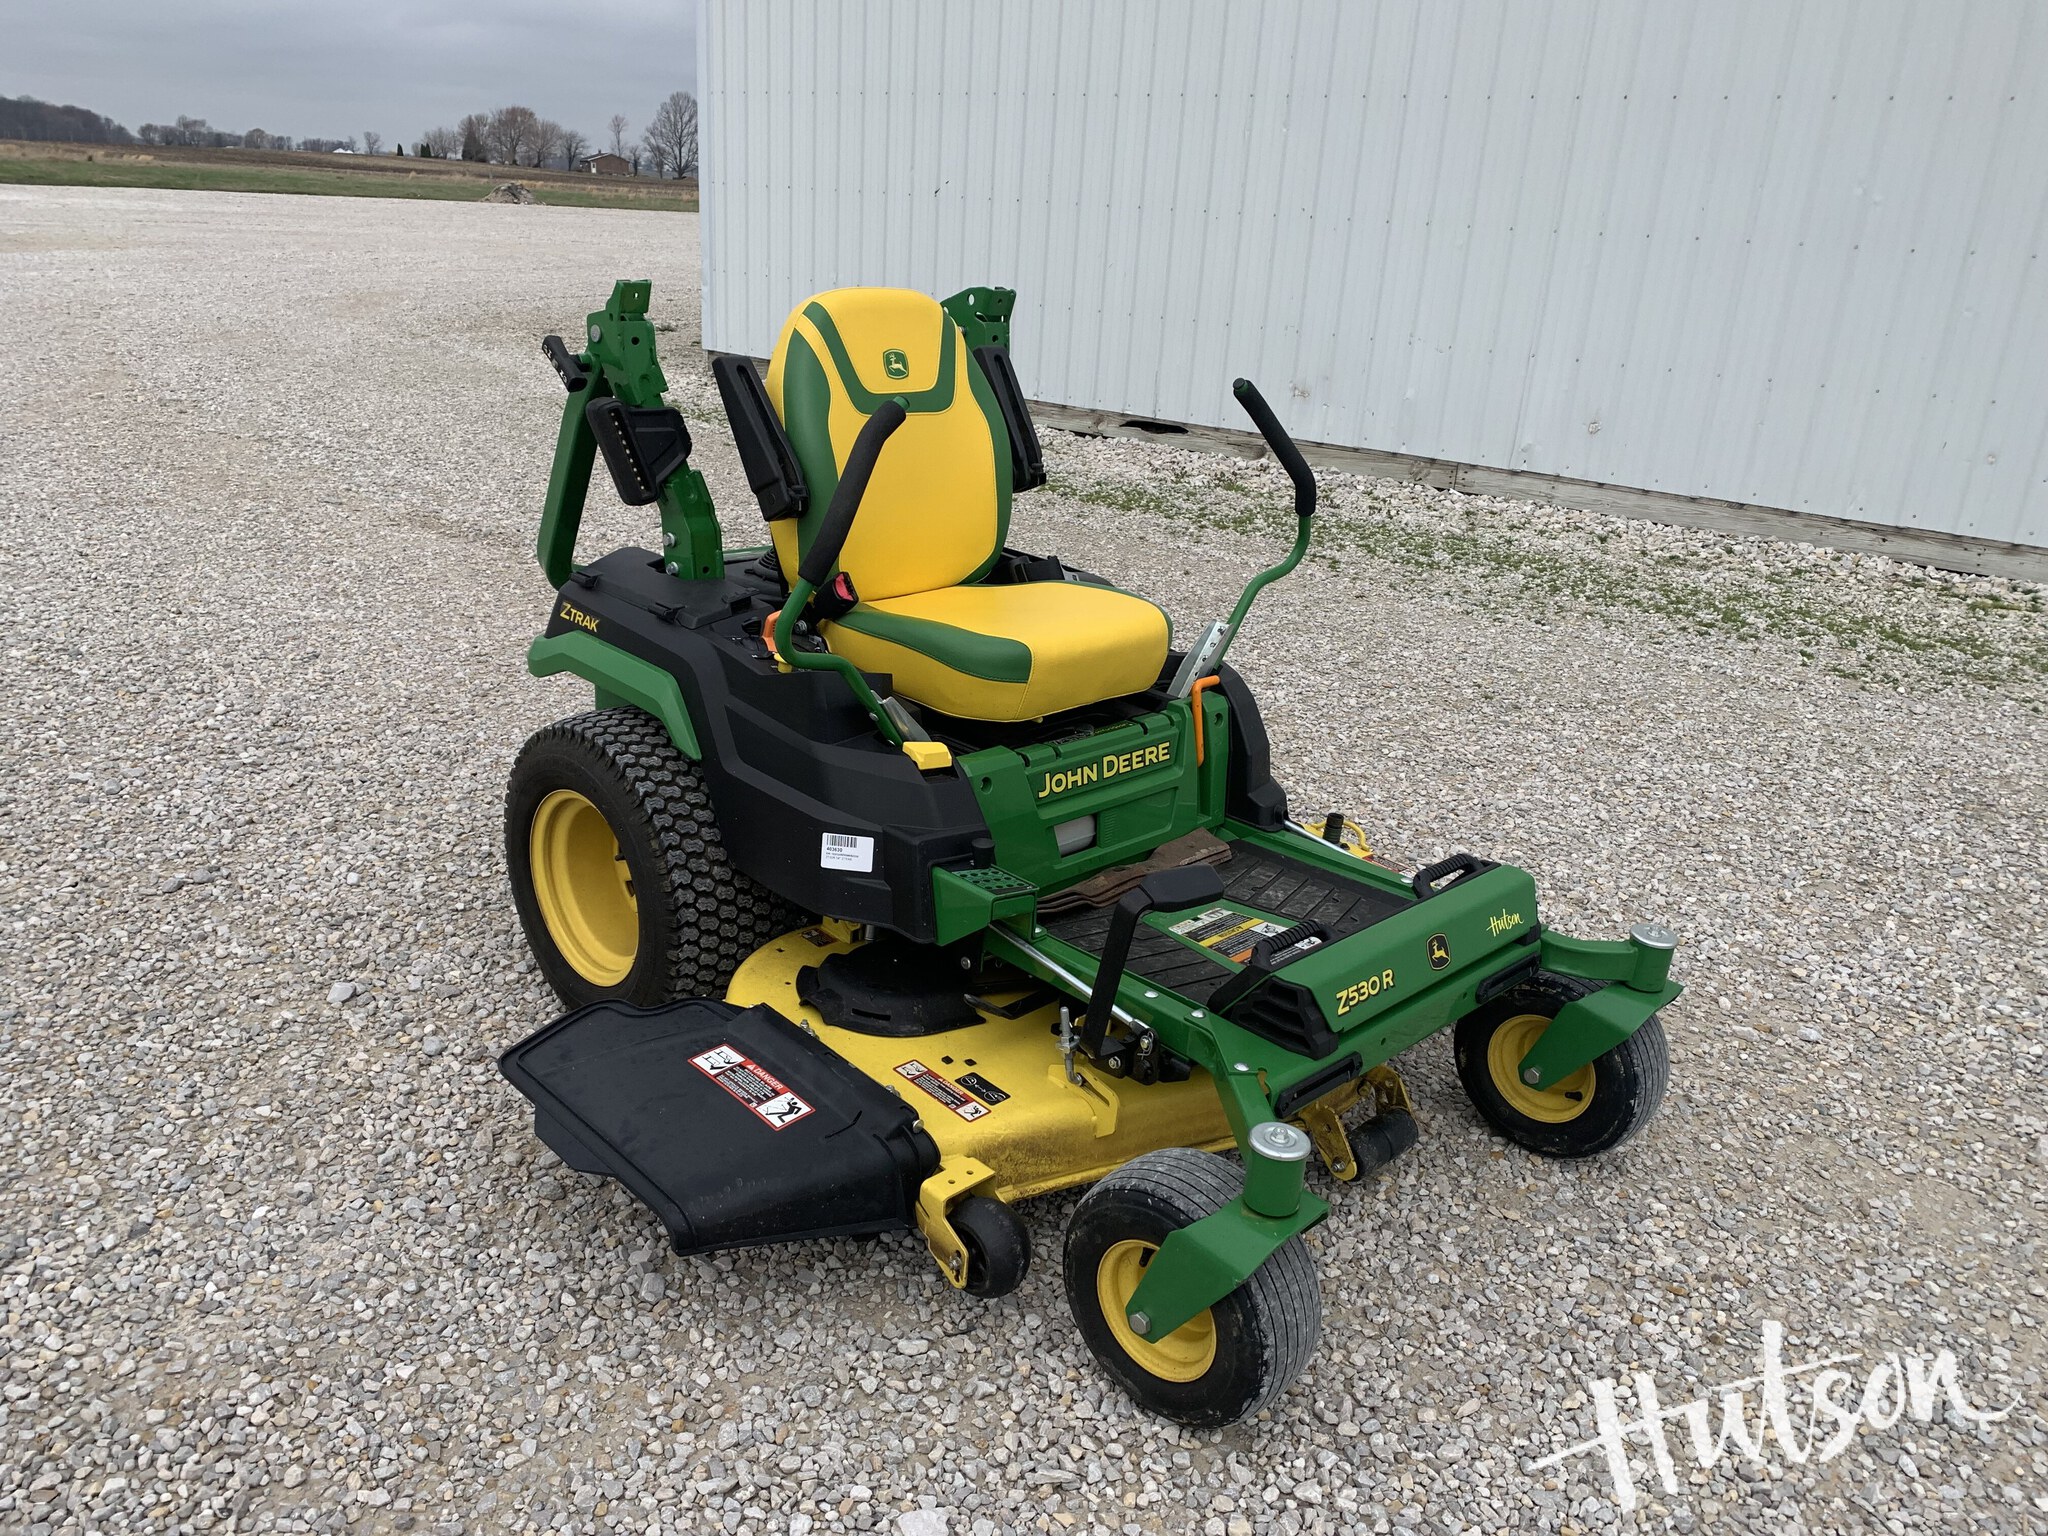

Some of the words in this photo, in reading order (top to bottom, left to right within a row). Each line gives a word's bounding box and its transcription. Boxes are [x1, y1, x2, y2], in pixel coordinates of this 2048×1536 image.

[1038, 763, 1098, 798] JOHN
[1102, 741, 1170, 779] DEERE
[1486, 908, 1524, 937] Hutson
[753, 1068, 784, 1090] DANGER
[942, 1080, 965, 1096] DANGER
